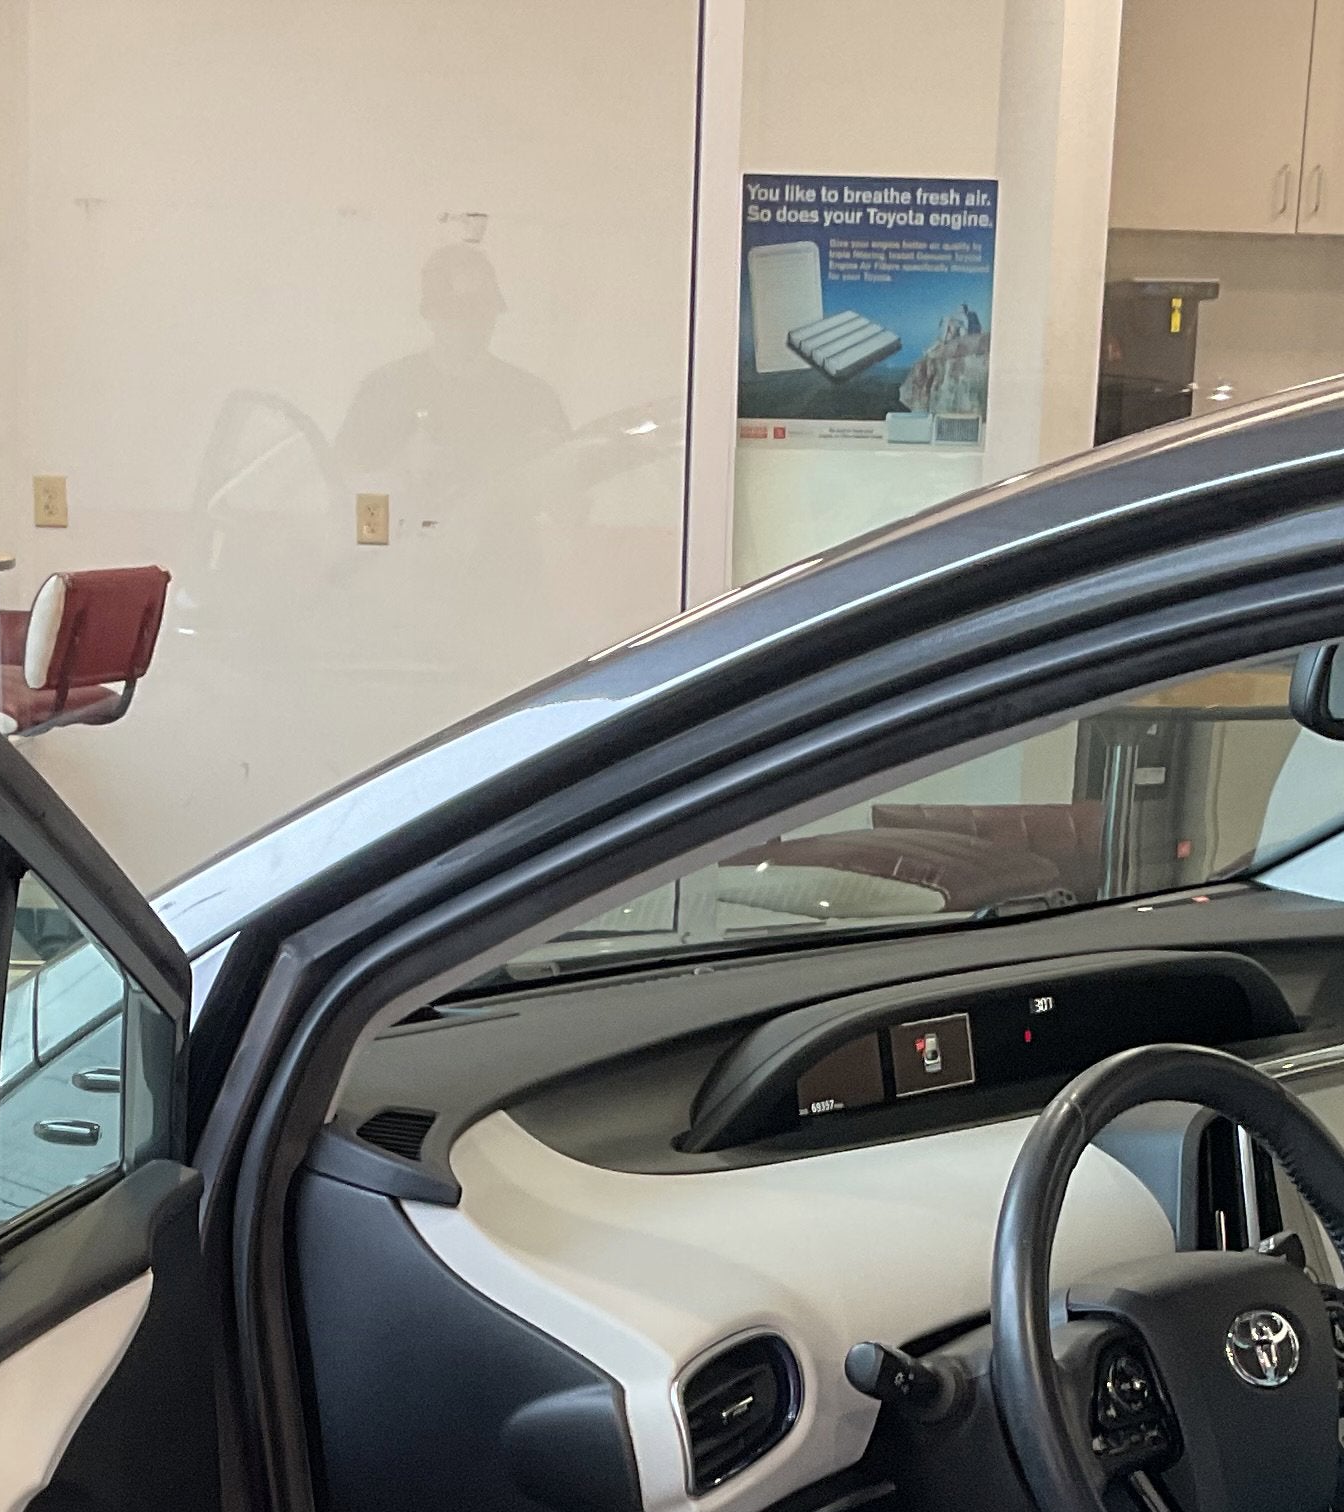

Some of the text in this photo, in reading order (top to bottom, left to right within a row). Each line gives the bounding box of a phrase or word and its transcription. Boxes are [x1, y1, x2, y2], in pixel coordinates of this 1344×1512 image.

[747, 183, 991, 206] You like to breathe fresh air.
[747, 205, 993, 231] So does your Toyota engine.
